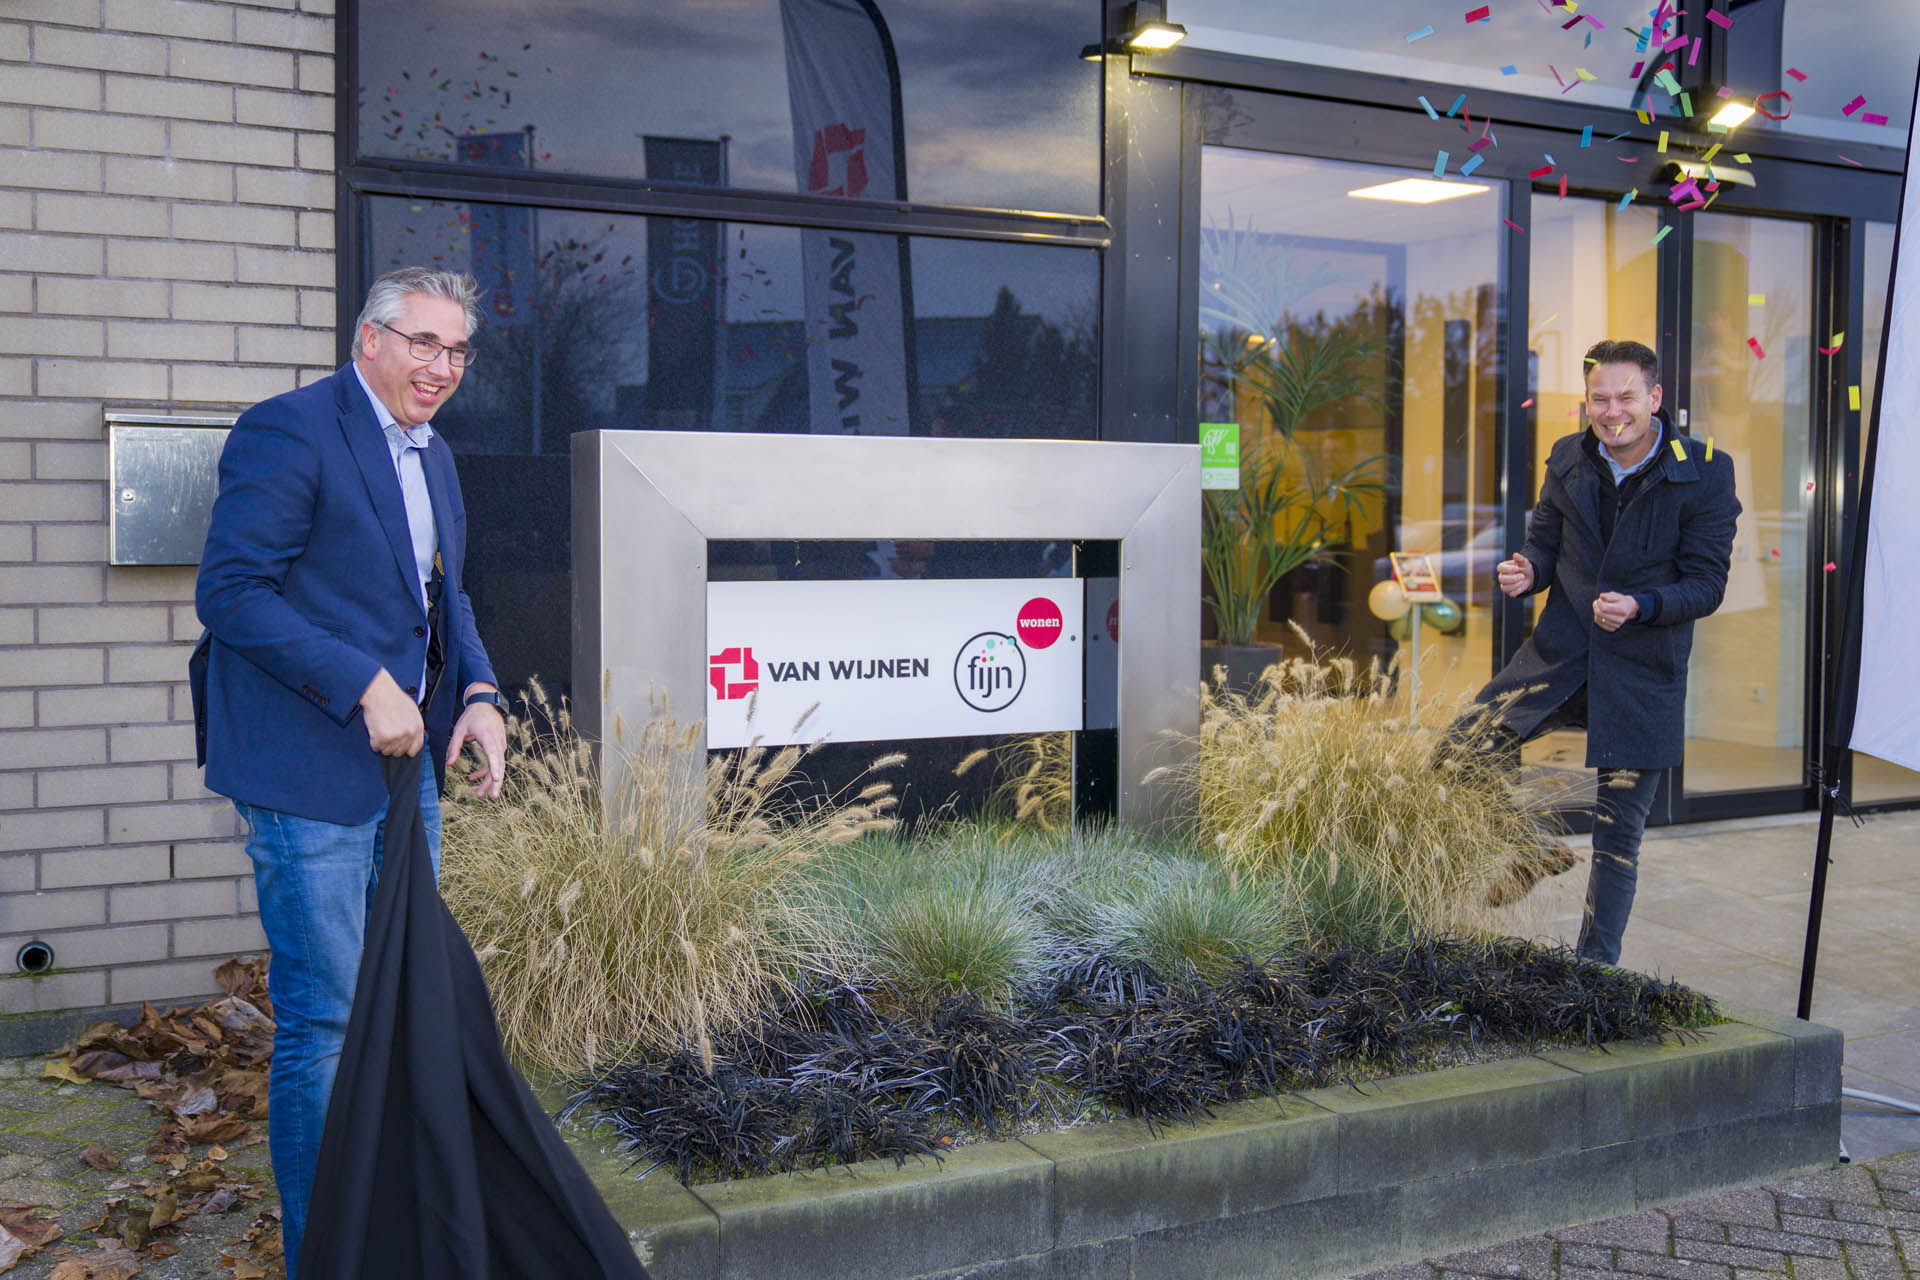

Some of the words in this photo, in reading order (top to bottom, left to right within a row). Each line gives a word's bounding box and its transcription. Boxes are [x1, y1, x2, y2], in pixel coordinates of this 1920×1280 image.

[1019, 618, 1060, 628] wonen
[767, 661, 820, 682] VAN
[828, 658, 929, 680] WIJNEN
[967, 655, 1012, 698] fijn
